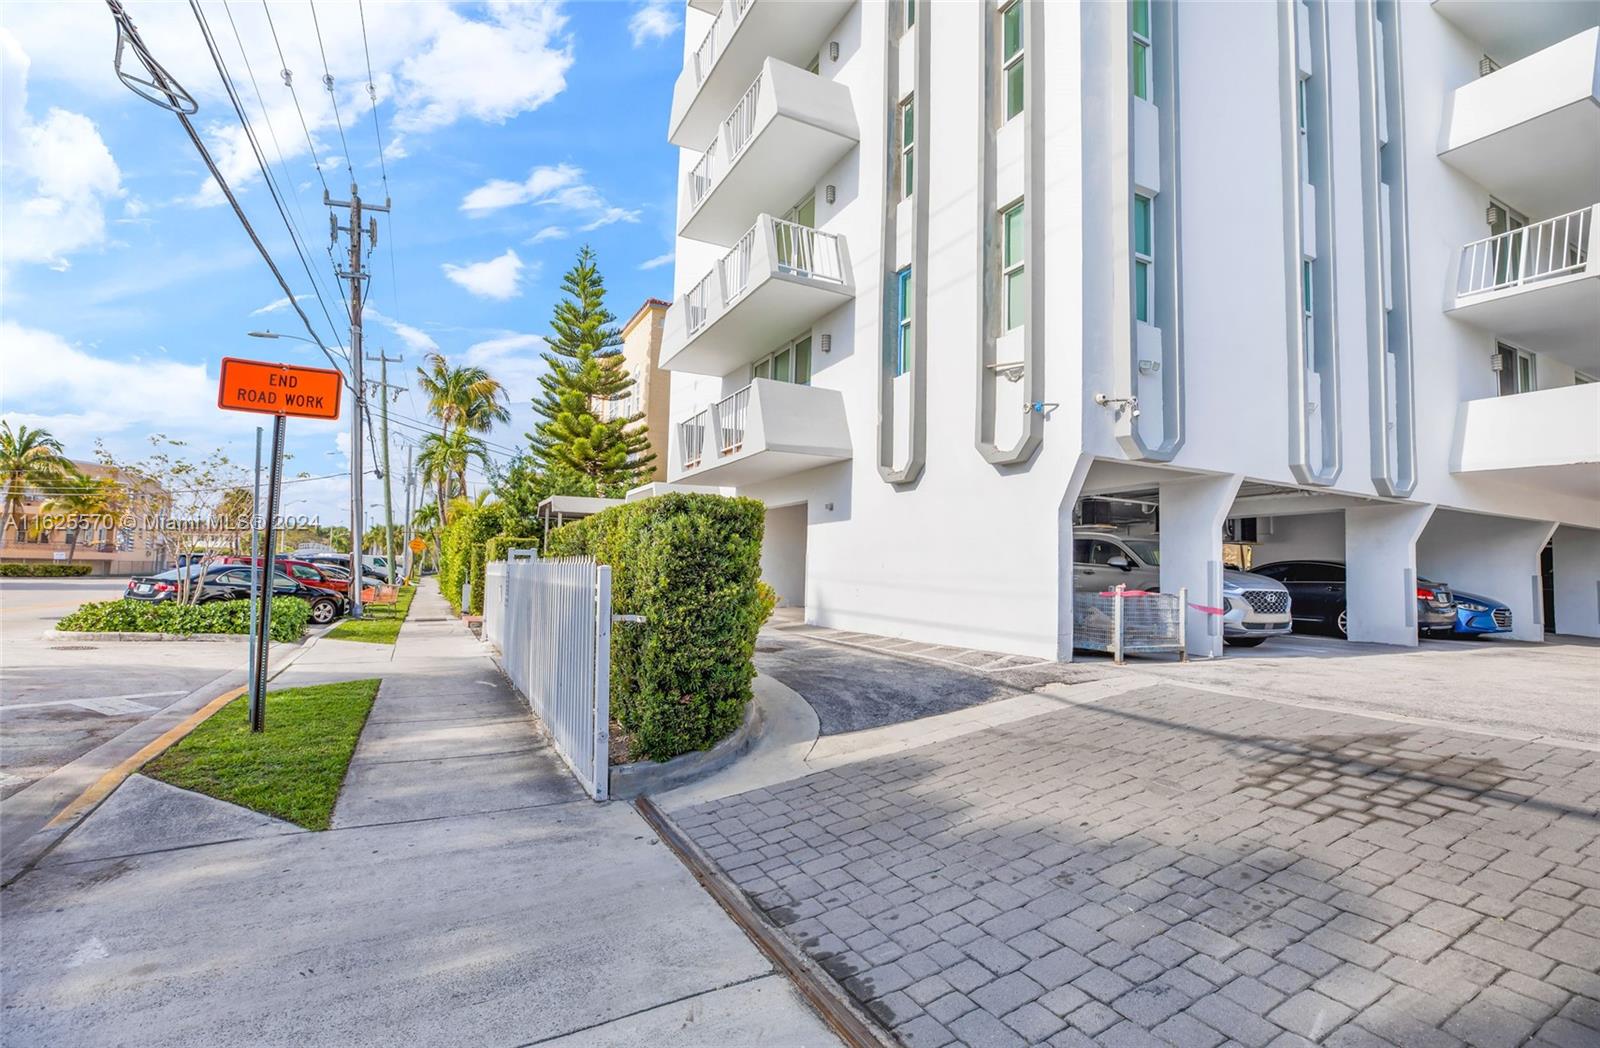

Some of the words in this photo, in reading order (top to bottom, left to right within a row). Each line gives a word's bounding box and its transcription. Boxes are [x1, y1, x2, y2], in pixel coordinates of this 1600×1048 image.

[269, 373, 298, 388] END
[237, 388, 277, 404] ROAD
[285, 393, 324, 409] WORK
